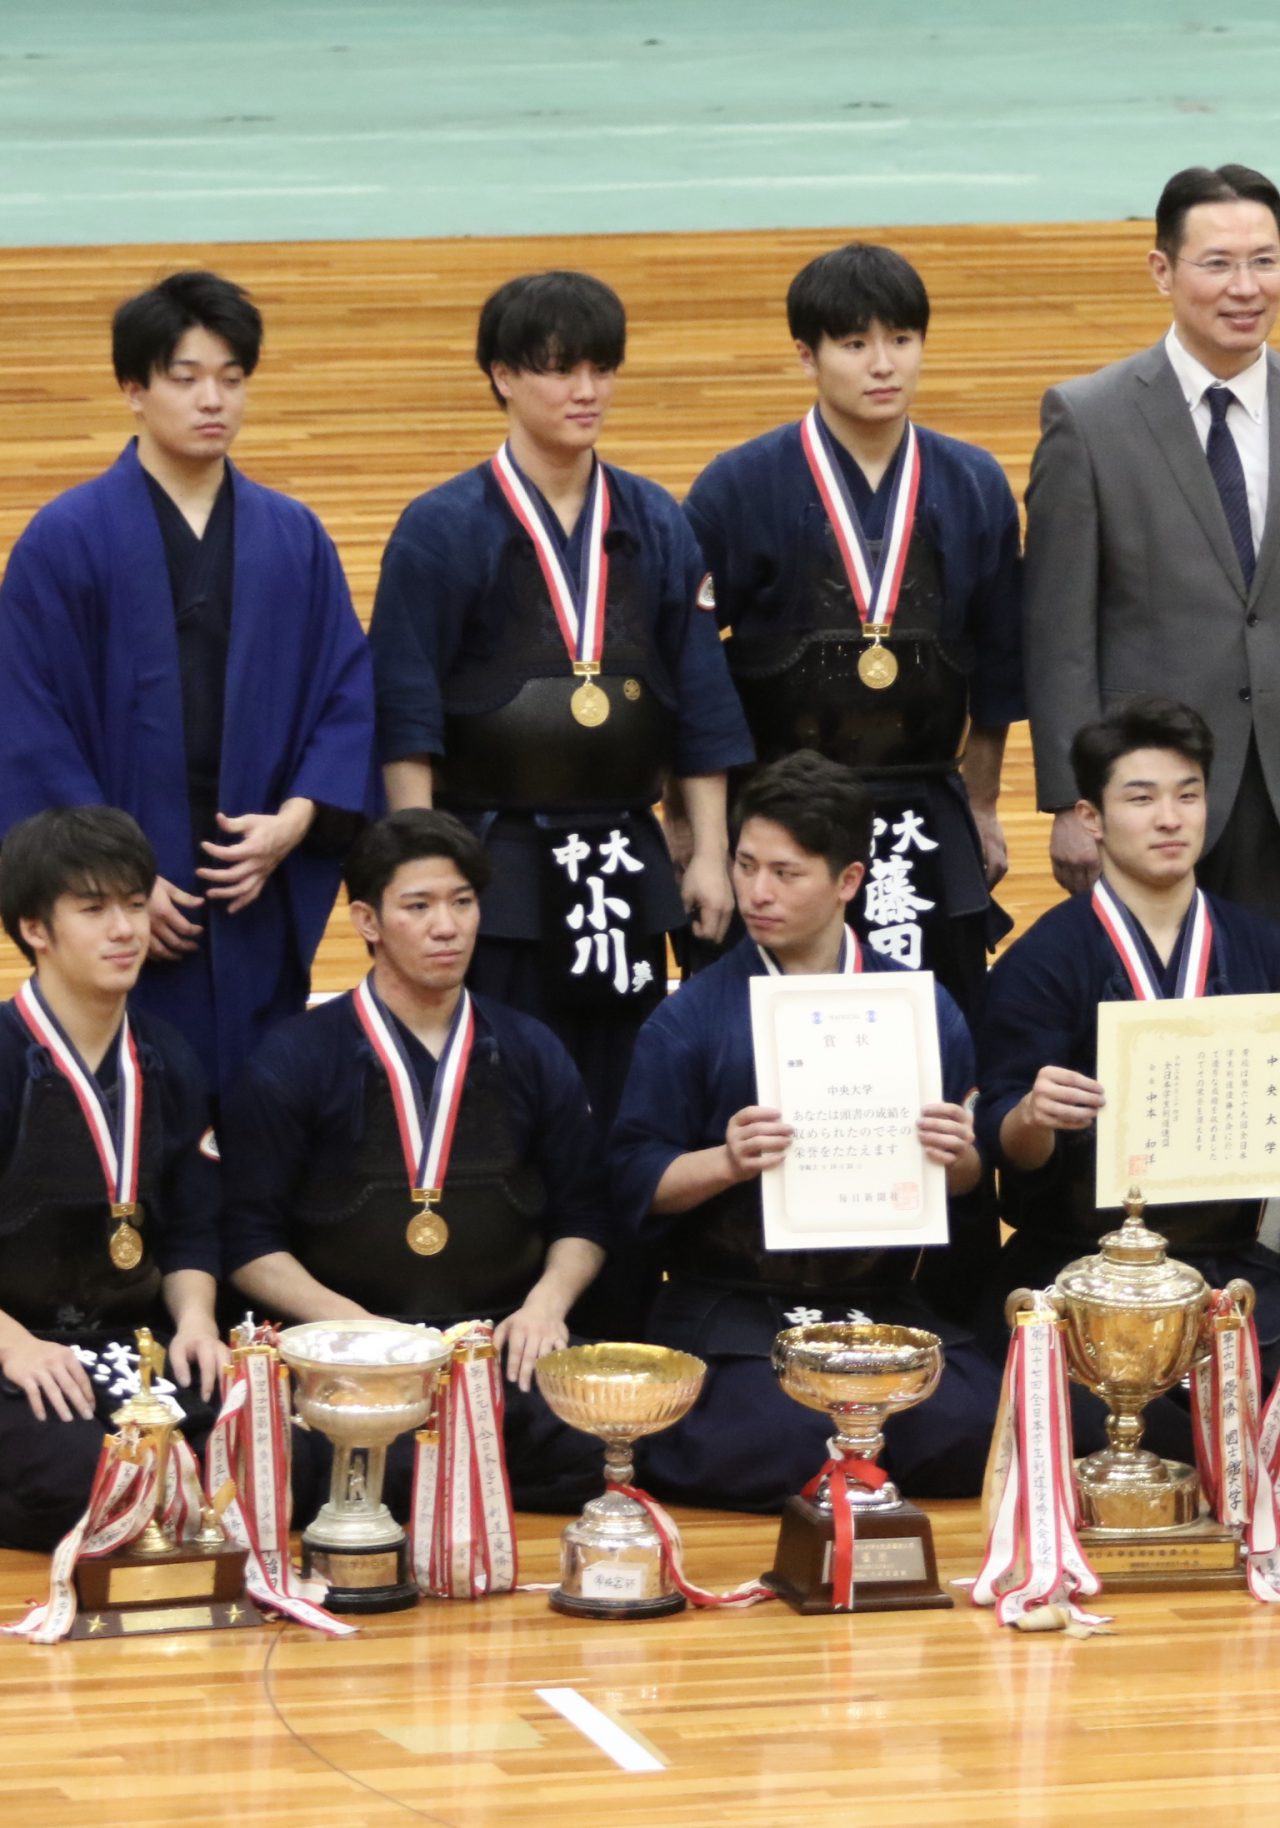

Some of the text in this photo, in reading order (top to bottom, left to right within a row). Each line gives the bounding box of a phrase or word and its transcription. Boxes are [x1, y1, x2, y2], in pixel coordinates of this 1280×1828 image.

[552, 829, 645, 882] 中大
[864, 854, 936, 970] 藤田
[566, 876, 632, 994] 小川
[826, 1083, 874, 1097] 中央大学
[1264, 1055, 1279, 1155] 中央大学
[793, 1107, 911, 1121] あなたは頭書の成績を
[794, 1144, 899, 1159] 栄誉をたたえます
[838, 1191, 900, 1204] 毎日新聞社
